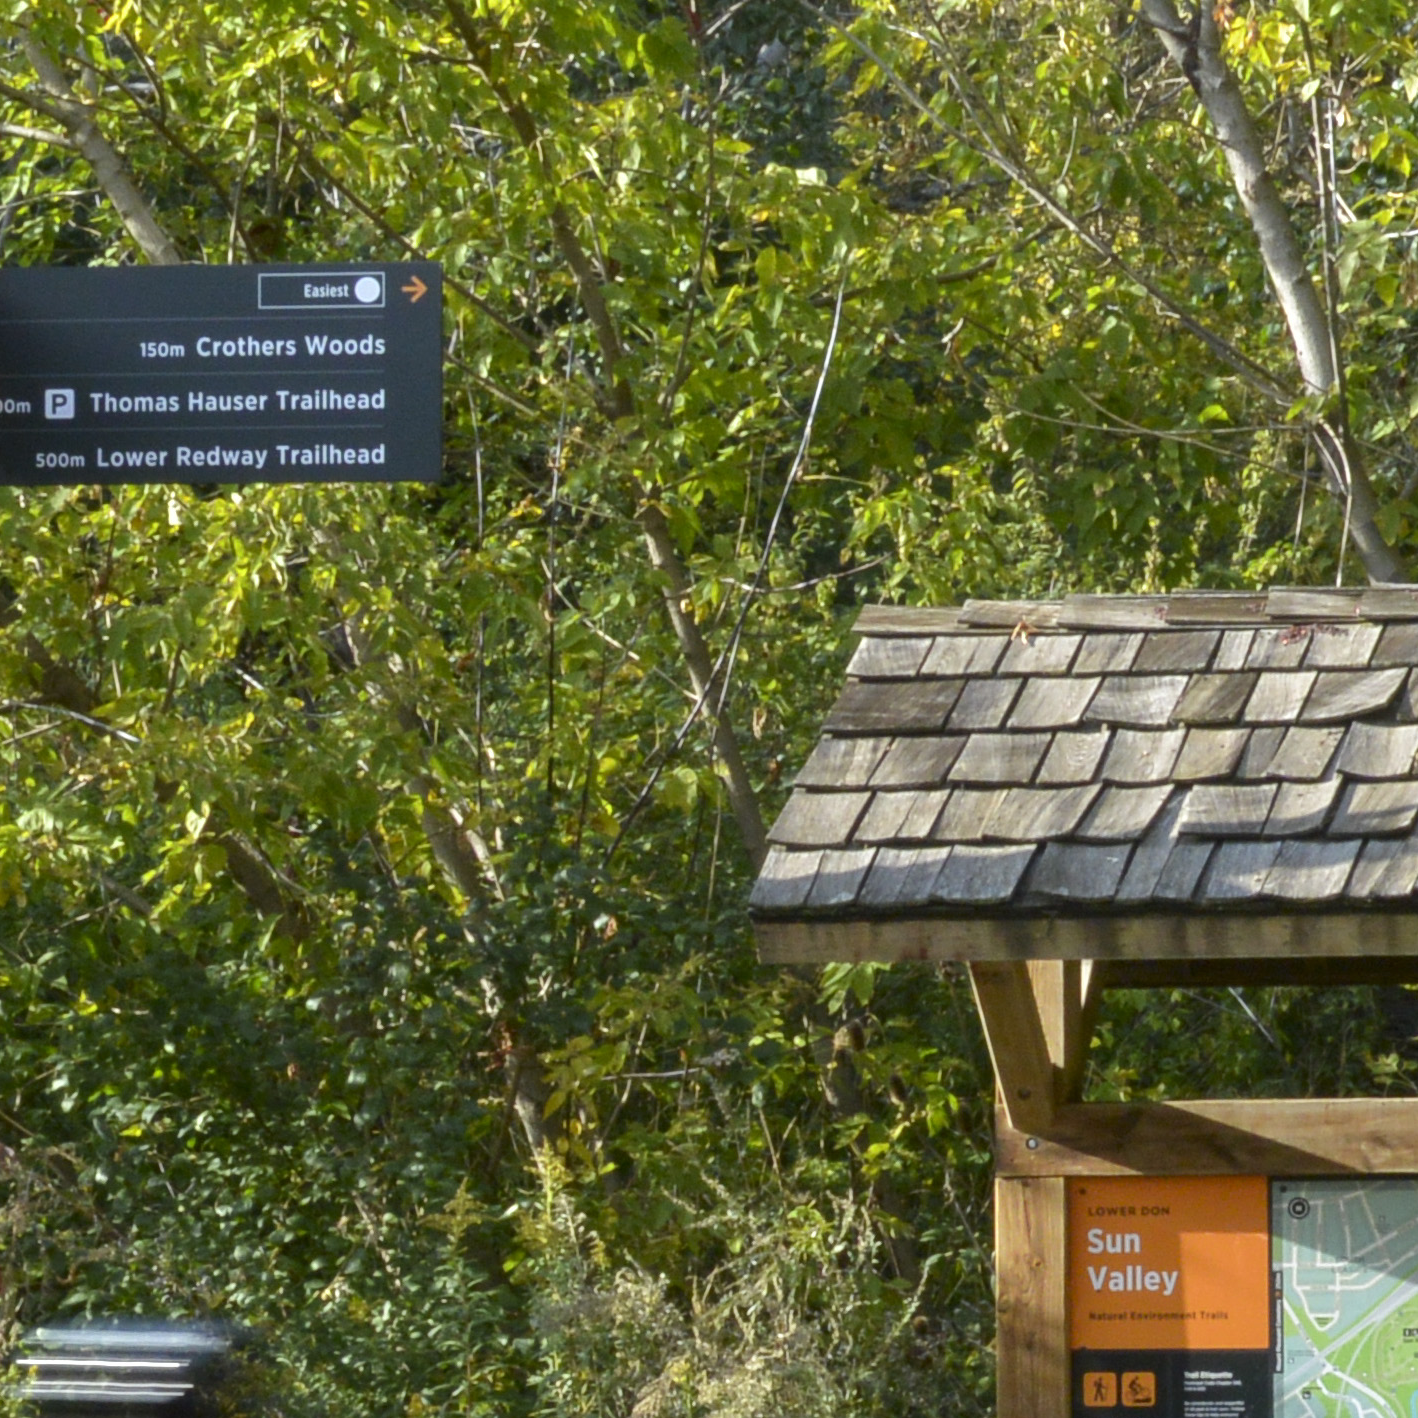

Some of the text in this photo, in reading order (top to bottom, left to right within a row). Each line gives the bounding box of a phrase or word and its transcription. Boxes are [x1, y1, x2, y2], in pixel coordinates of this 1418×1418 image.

[304, 283, 349, 298] Easiest
[140, 335, 386, 358] 150m Crothers Woods
[90, 392, 179, 413] Thomas
[188, 391, 267, 411] Hauser
[276, 389, 385, 410] Trailhead
[36, 444, 385, 469] 500m Lower Redway Trailhead
[1088, 1206, 1170, 1216] LOWER DON
[1087, 1228, 1141, 1254] Sun
[1087, 1265, 1178, 1295] Valley
[1089, 1312, 1228, 1320] Natural Environment Trails
